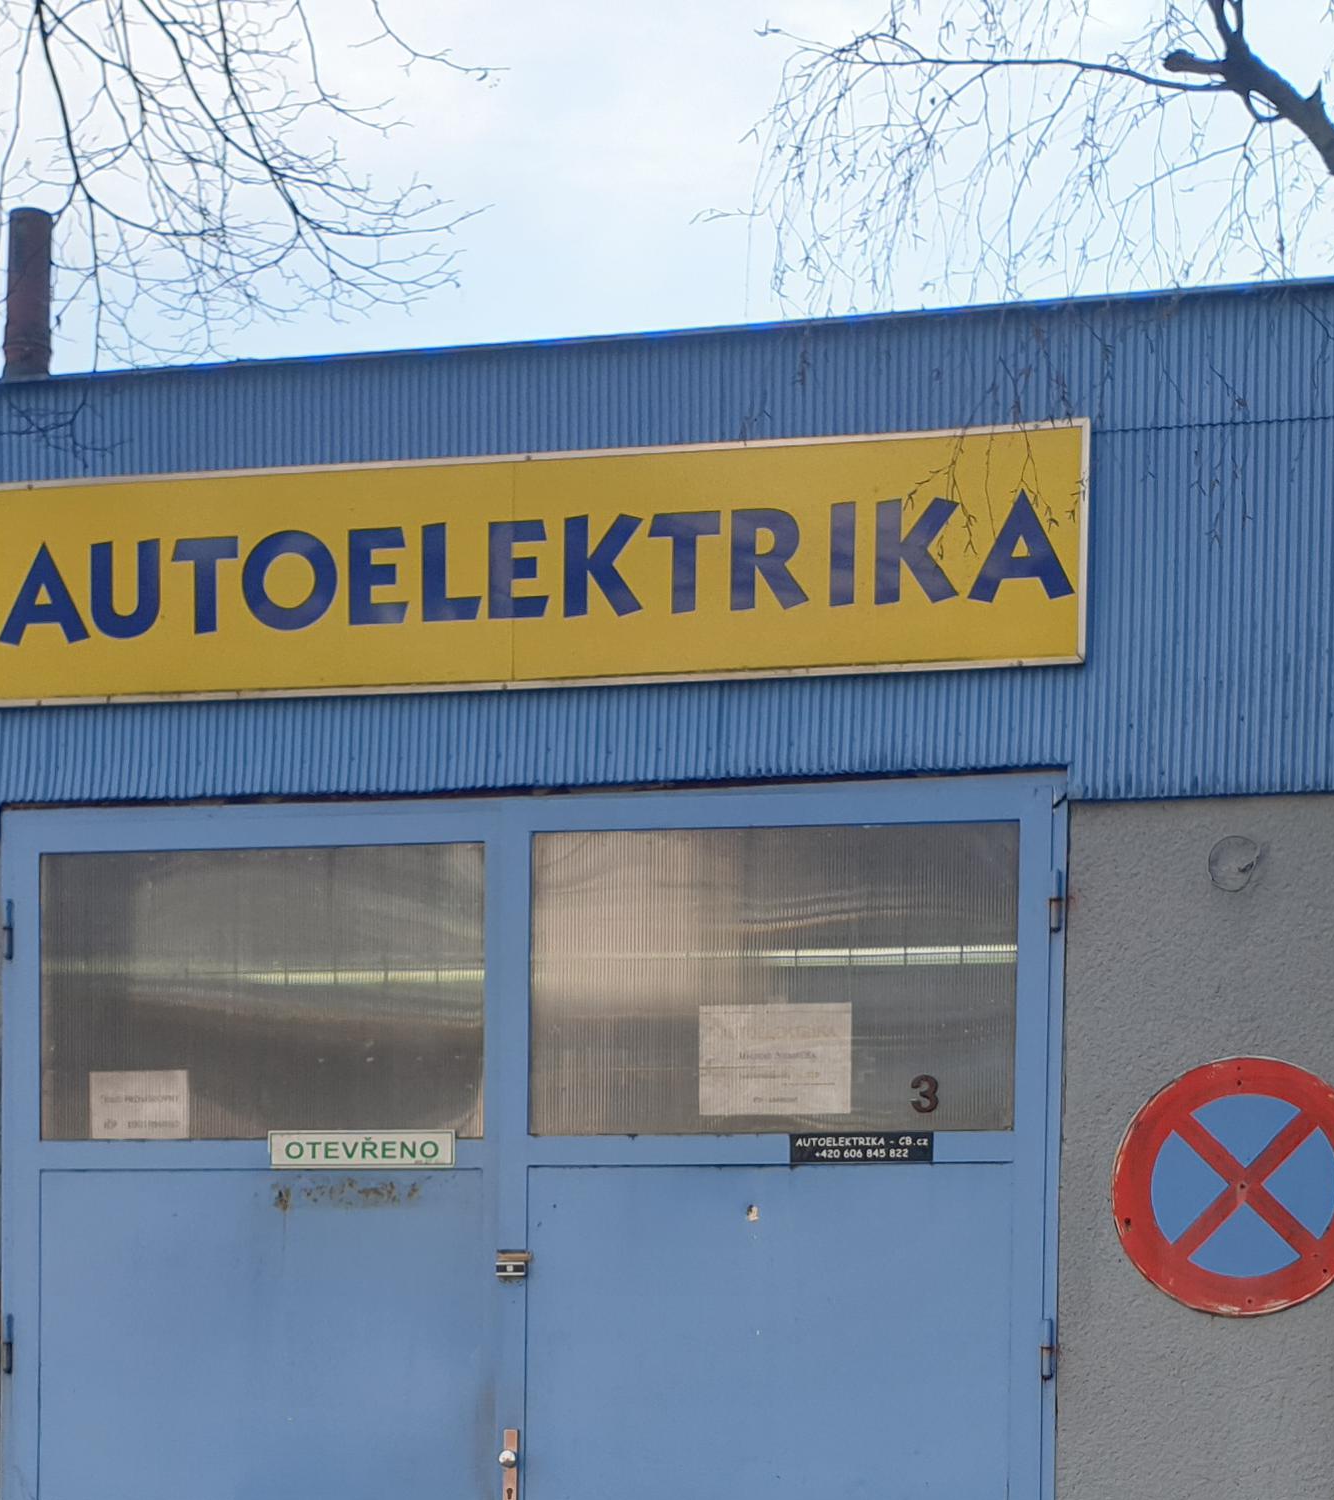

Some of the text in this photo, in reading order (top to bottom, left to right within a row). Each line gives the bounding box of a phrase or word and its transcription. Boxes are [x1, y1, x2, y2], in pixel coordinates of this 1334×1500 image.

[0, 487, 1075, 646] AUTOELEKTRIKA
[910, 1074, 939, 1113] 3
[285, 1136, 439, 1159] OTEVŘENO
[795, 1136, 885, 1147] AUTOELEKTRIKA
[899, 1136, 929, 1146] CB.cz
[815, 1148, 909, 1158] +420 606 845 822
